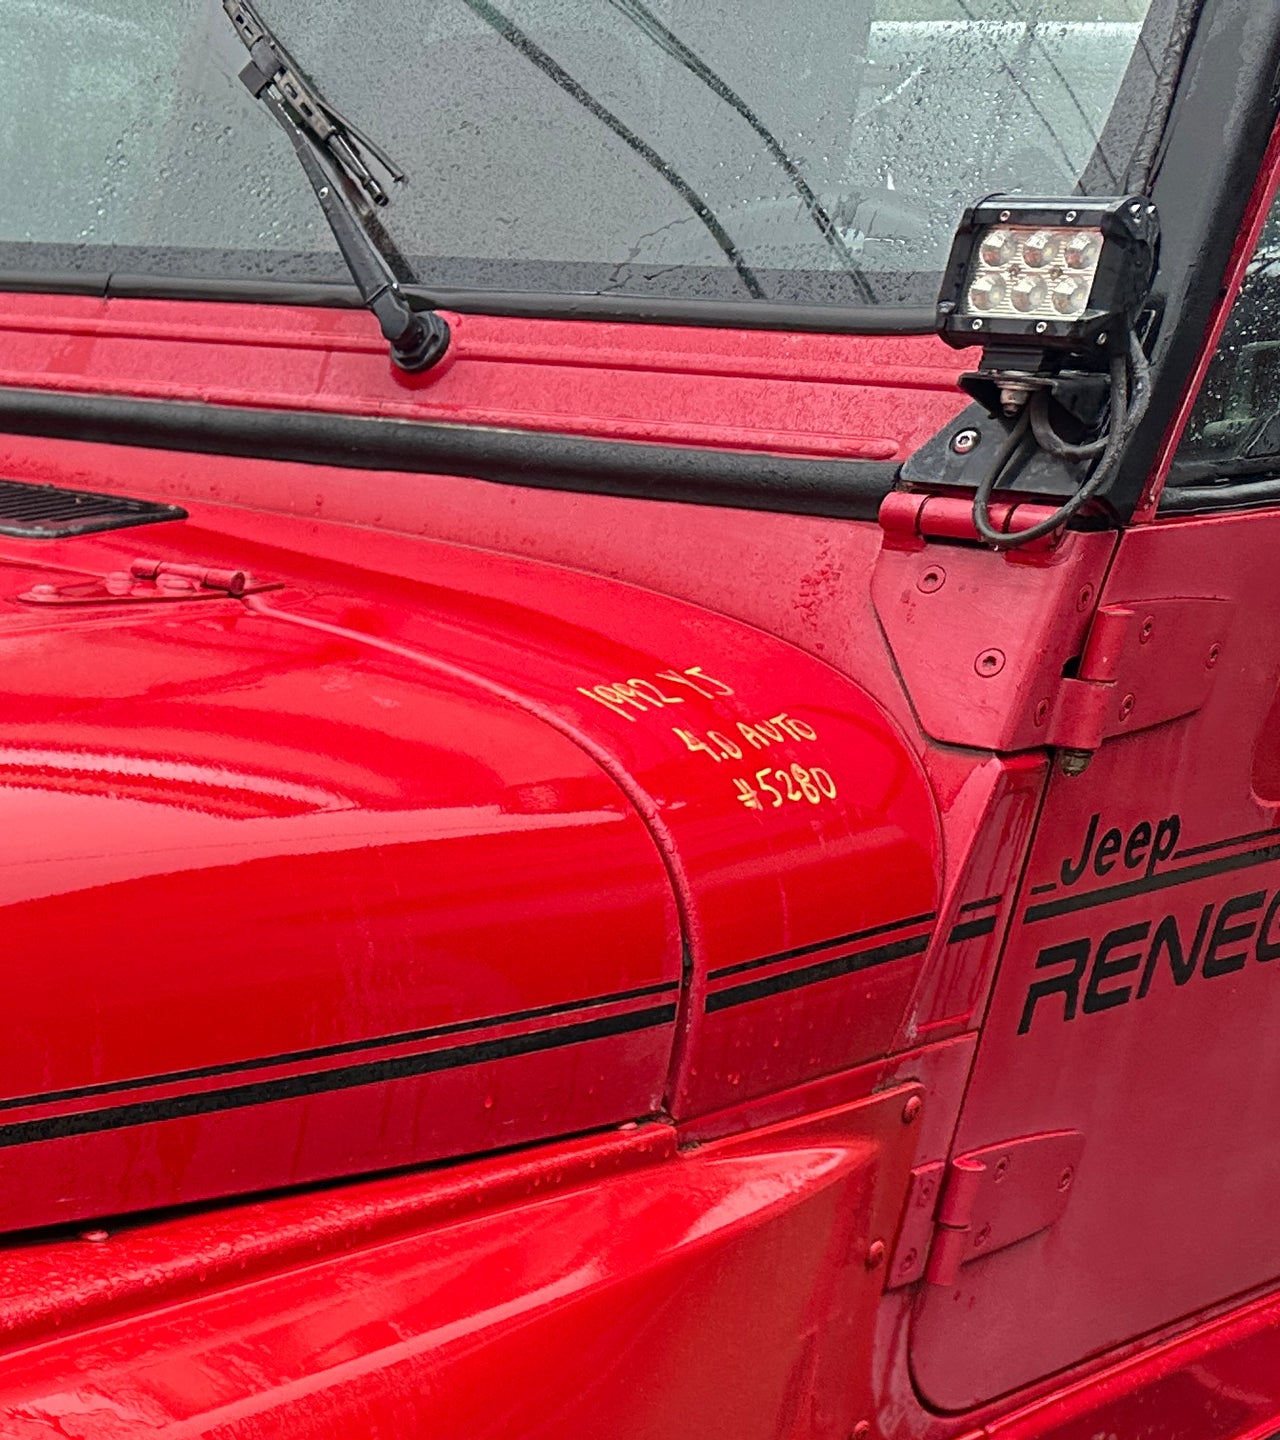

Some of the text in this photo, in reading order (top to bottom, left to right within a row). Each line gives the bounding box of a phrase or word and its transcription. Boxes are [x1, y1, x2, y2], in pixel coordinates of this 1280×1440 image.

[576, 677, 685, 722] 1992
[671, 712, 818, 763] 4.0 AUTO
[732, 762, 837, 811] #5280
[1060, 813, 1181, 879] Jeep
